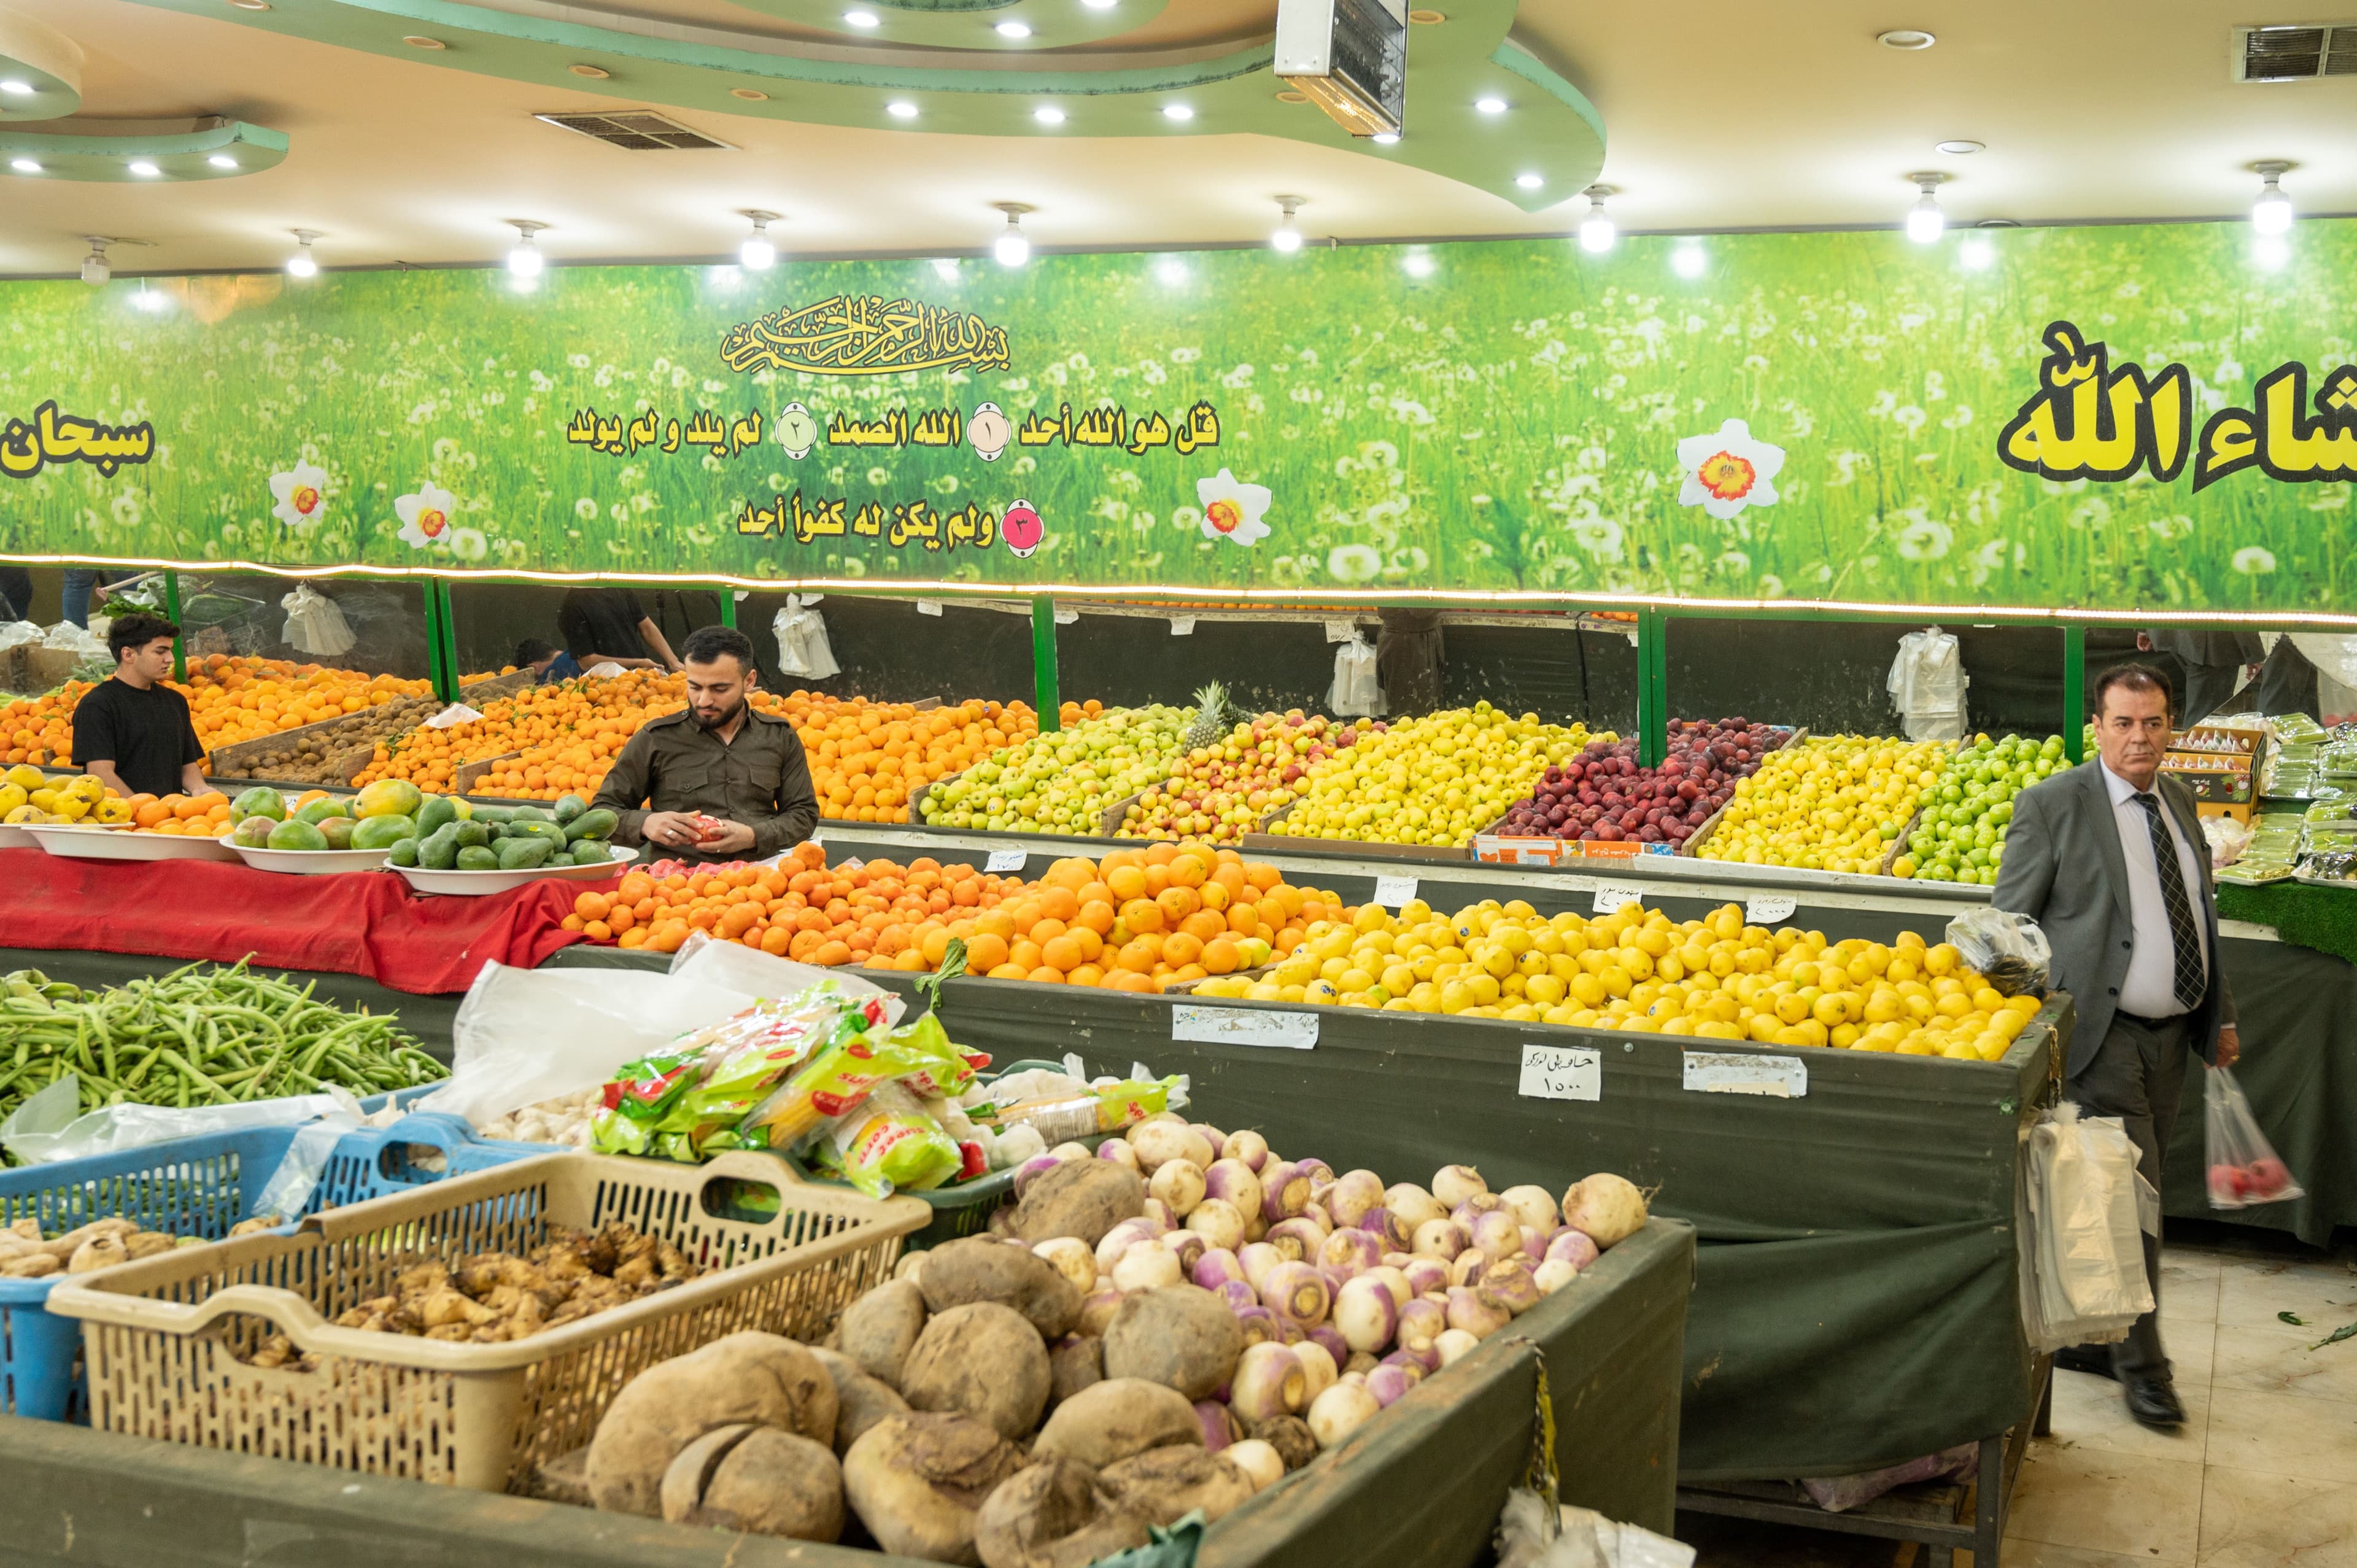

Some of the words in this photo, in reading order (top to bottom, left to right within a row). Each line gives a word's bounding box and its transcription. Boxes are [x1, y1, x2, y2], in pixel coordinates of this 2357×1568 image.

[1018, 403, 1073, 448] أحد
[1997, 320, 2192, 482] الله
[0, 399, 155, 479] سبحان
[567, 406, 627, 458] يولد
[628, 406, 660, 459] لم
[684, 409, 730, 459] يلد
[731, 408, 761, 460] لم
[827, 406, 910, 449] الصمد
[911, 406, 962, 448] الله
[1073, 406, 1126, 448] الله
[1126, 411, 1171, 455] هو
[1175, 400, 1219, 455] قل
[737, 493, 787, 537] أحد
[851, 500, 884, 538] له
[887, 498, 943, 554] يكن
[945, 500, 996, 555] ولم
[1544, 1078, 1581, 1092] ١٥٠٠
